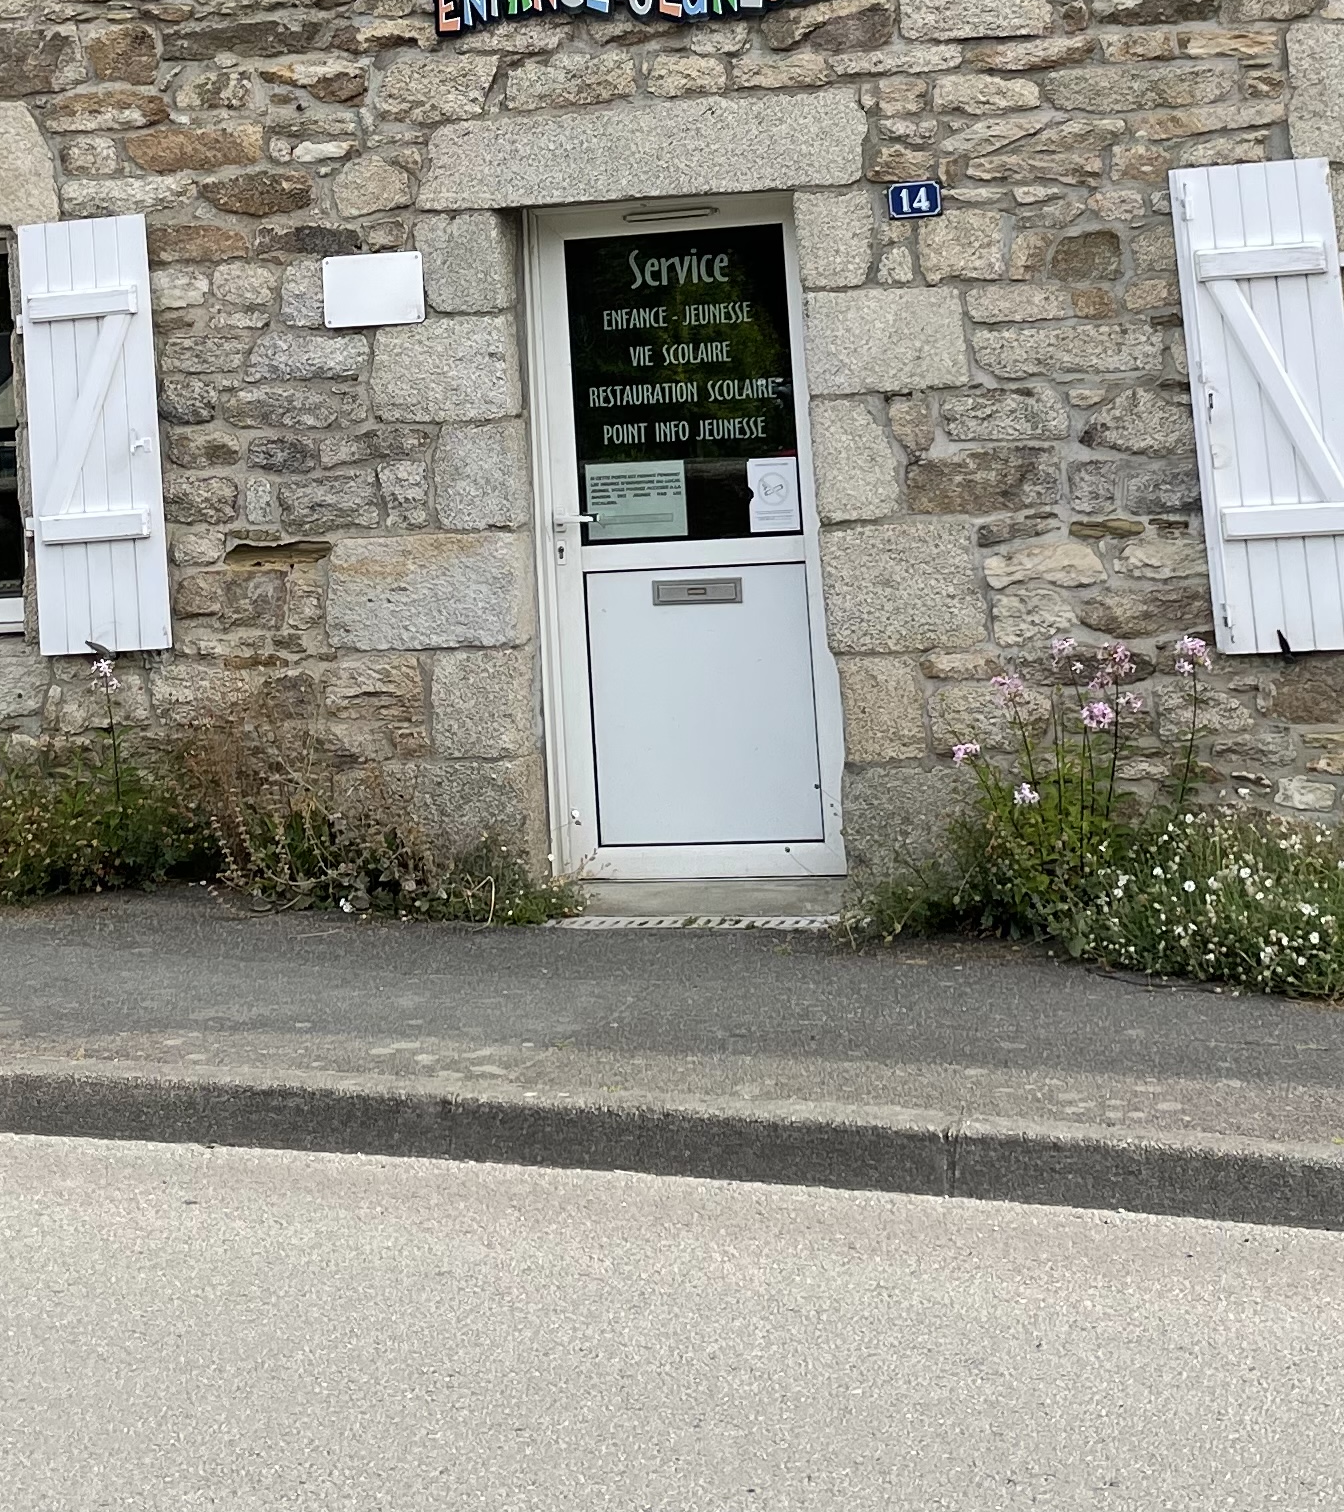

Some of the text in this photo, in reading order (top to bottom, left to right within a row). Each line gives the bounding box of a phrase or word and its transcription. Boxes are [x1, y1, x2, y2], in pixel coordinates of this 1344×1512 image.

[899, 186, 931, 213] 14
[628, 248, 729, 290] Service
[603, 306, 668, 331] ENFANCE
[682, 301, 753, 326] JEUNESSE
[629, 341, 732, 367] VIE SCOLAIRE
[589, 377, 778, 408] RESTAURATION SCOLAIRE
[603, 416, 767, 445] POINT INFO JEUNESSE
